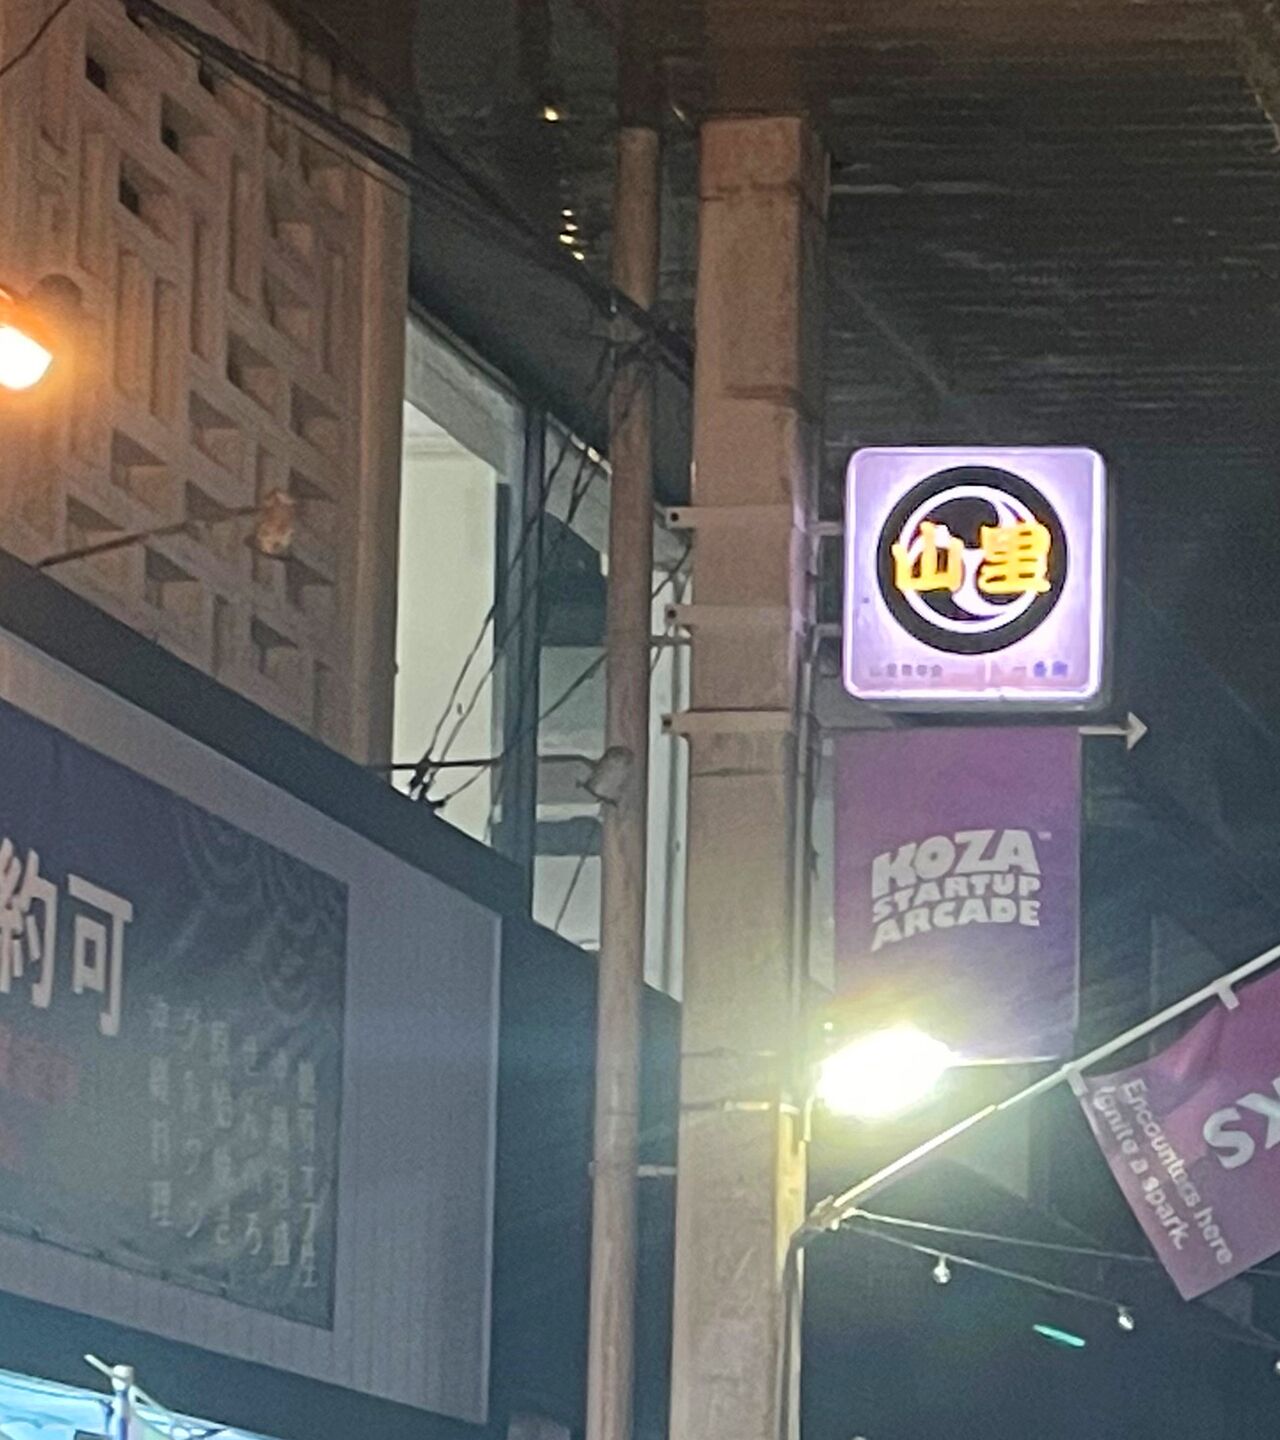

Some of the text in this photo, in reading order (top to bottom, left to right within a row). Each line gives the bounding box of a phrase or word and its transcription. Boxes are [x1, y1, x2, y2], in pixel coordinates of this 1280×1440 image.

[872, 828, 1040, 898] KOZA
[872, 873, 1040, 922] STARTUP
[872, 897, 1040, 953] ARCADE
[1194, 1205, 1233, 1266] here
